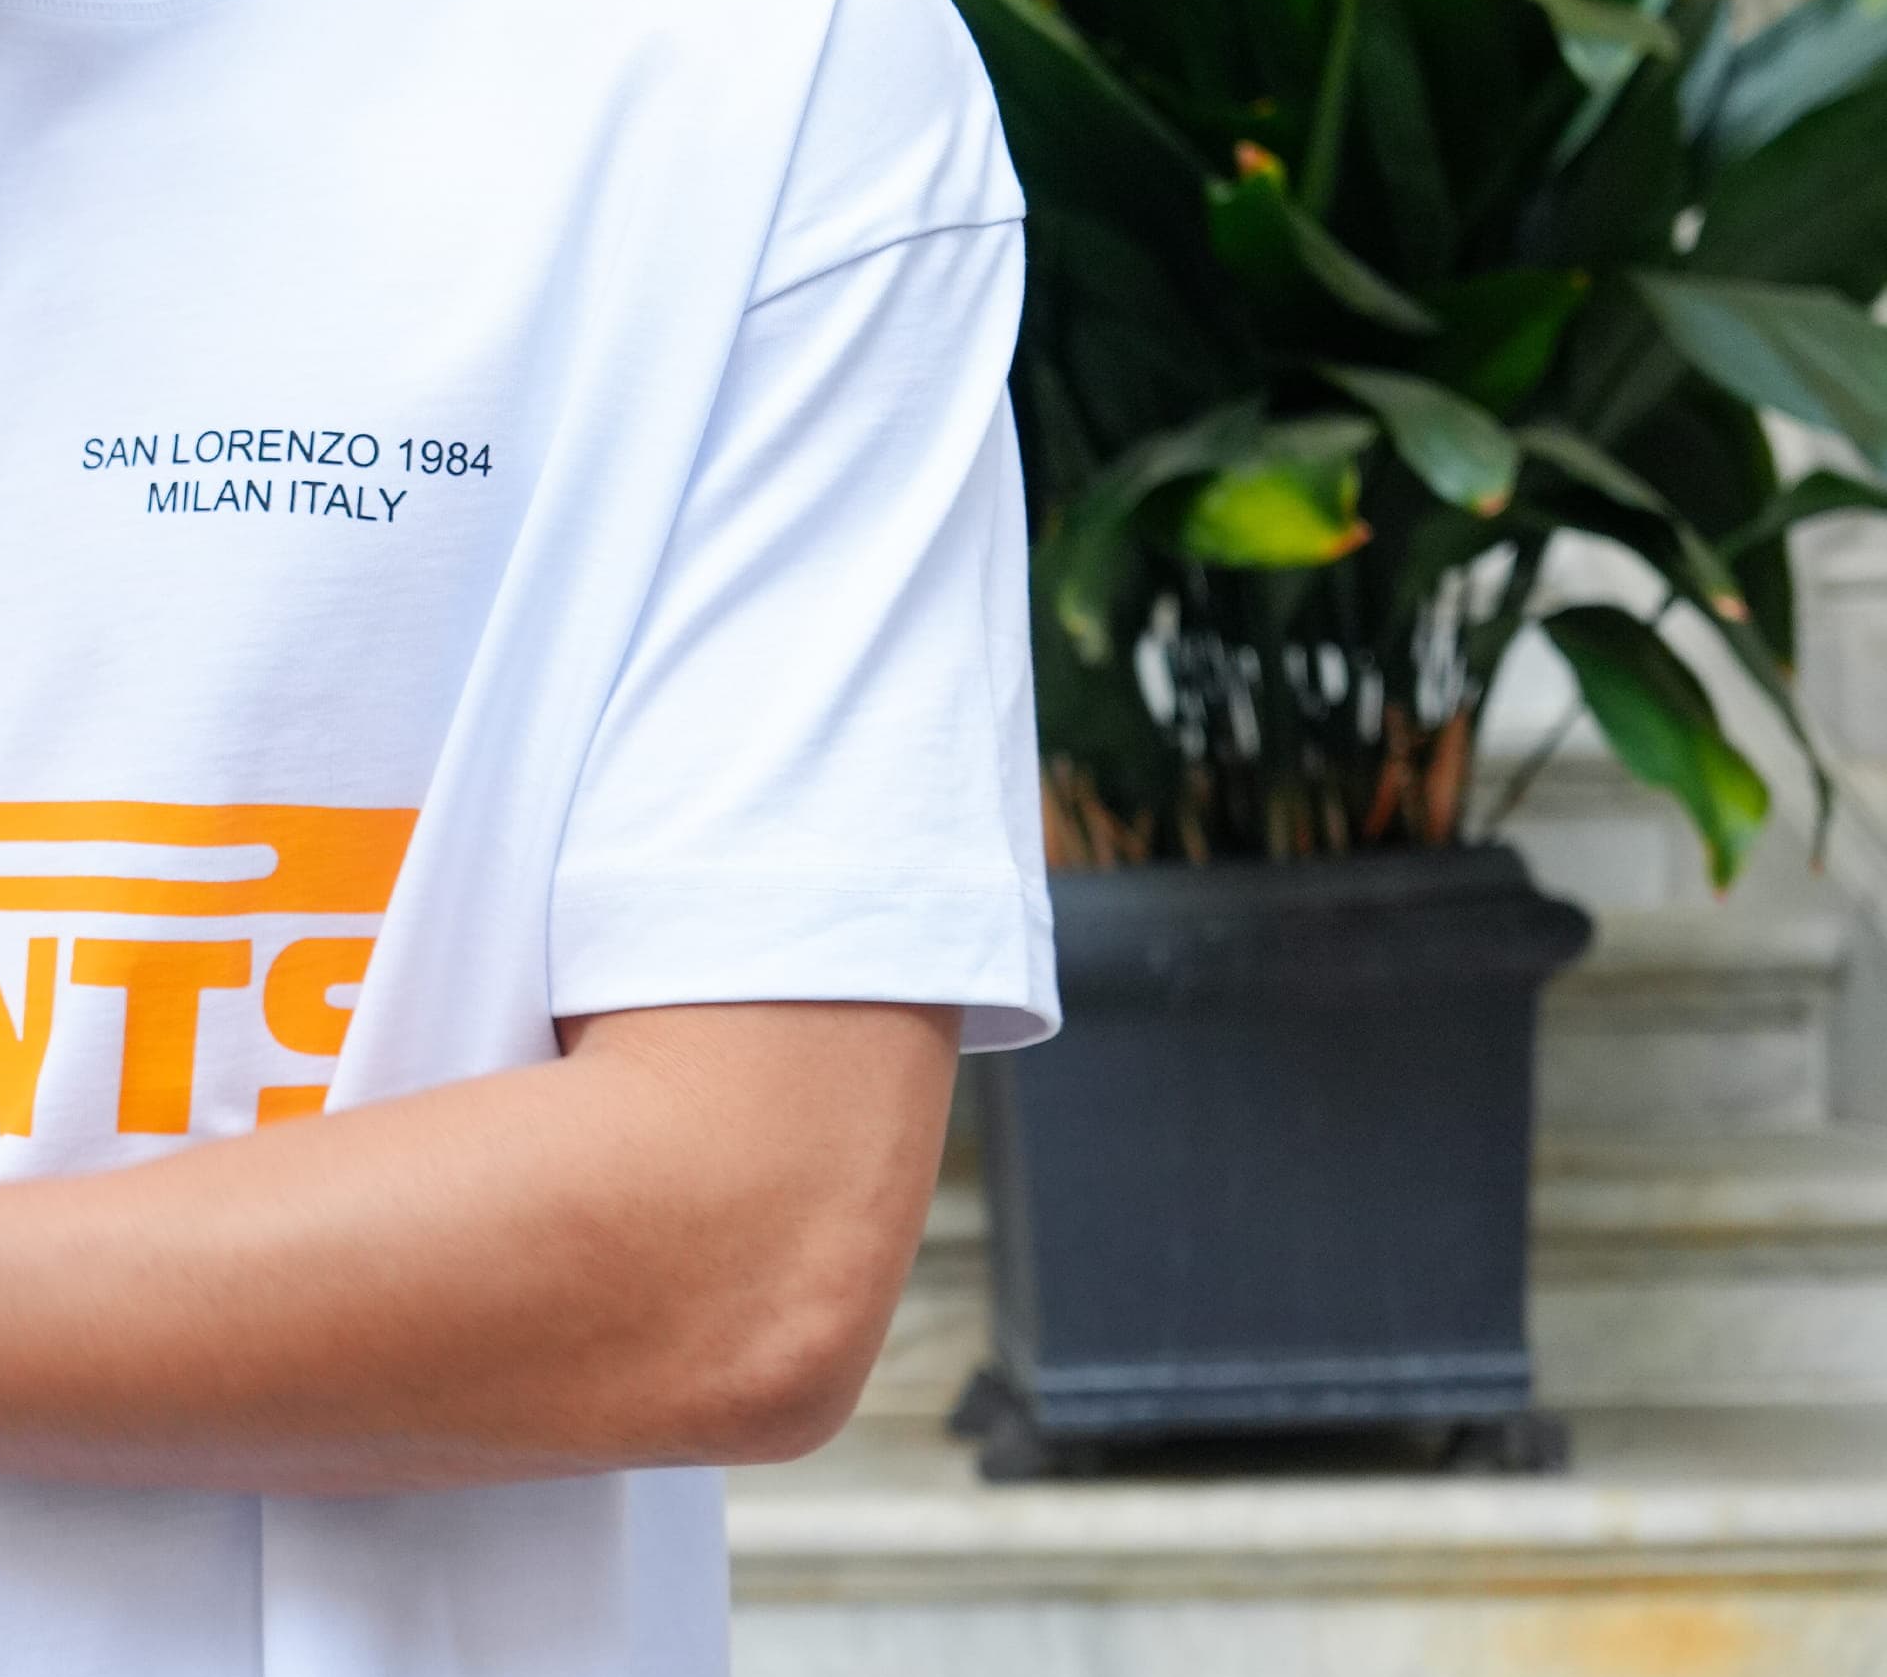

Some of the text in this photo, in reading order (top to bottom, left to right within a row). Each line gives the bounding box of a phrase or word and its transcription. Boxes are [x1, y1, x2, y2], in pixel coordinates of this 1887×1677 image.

[81, 428, 493, 477] SAN LORENZO 1984
[146, 479, 408, 523] MILAN ITALY
